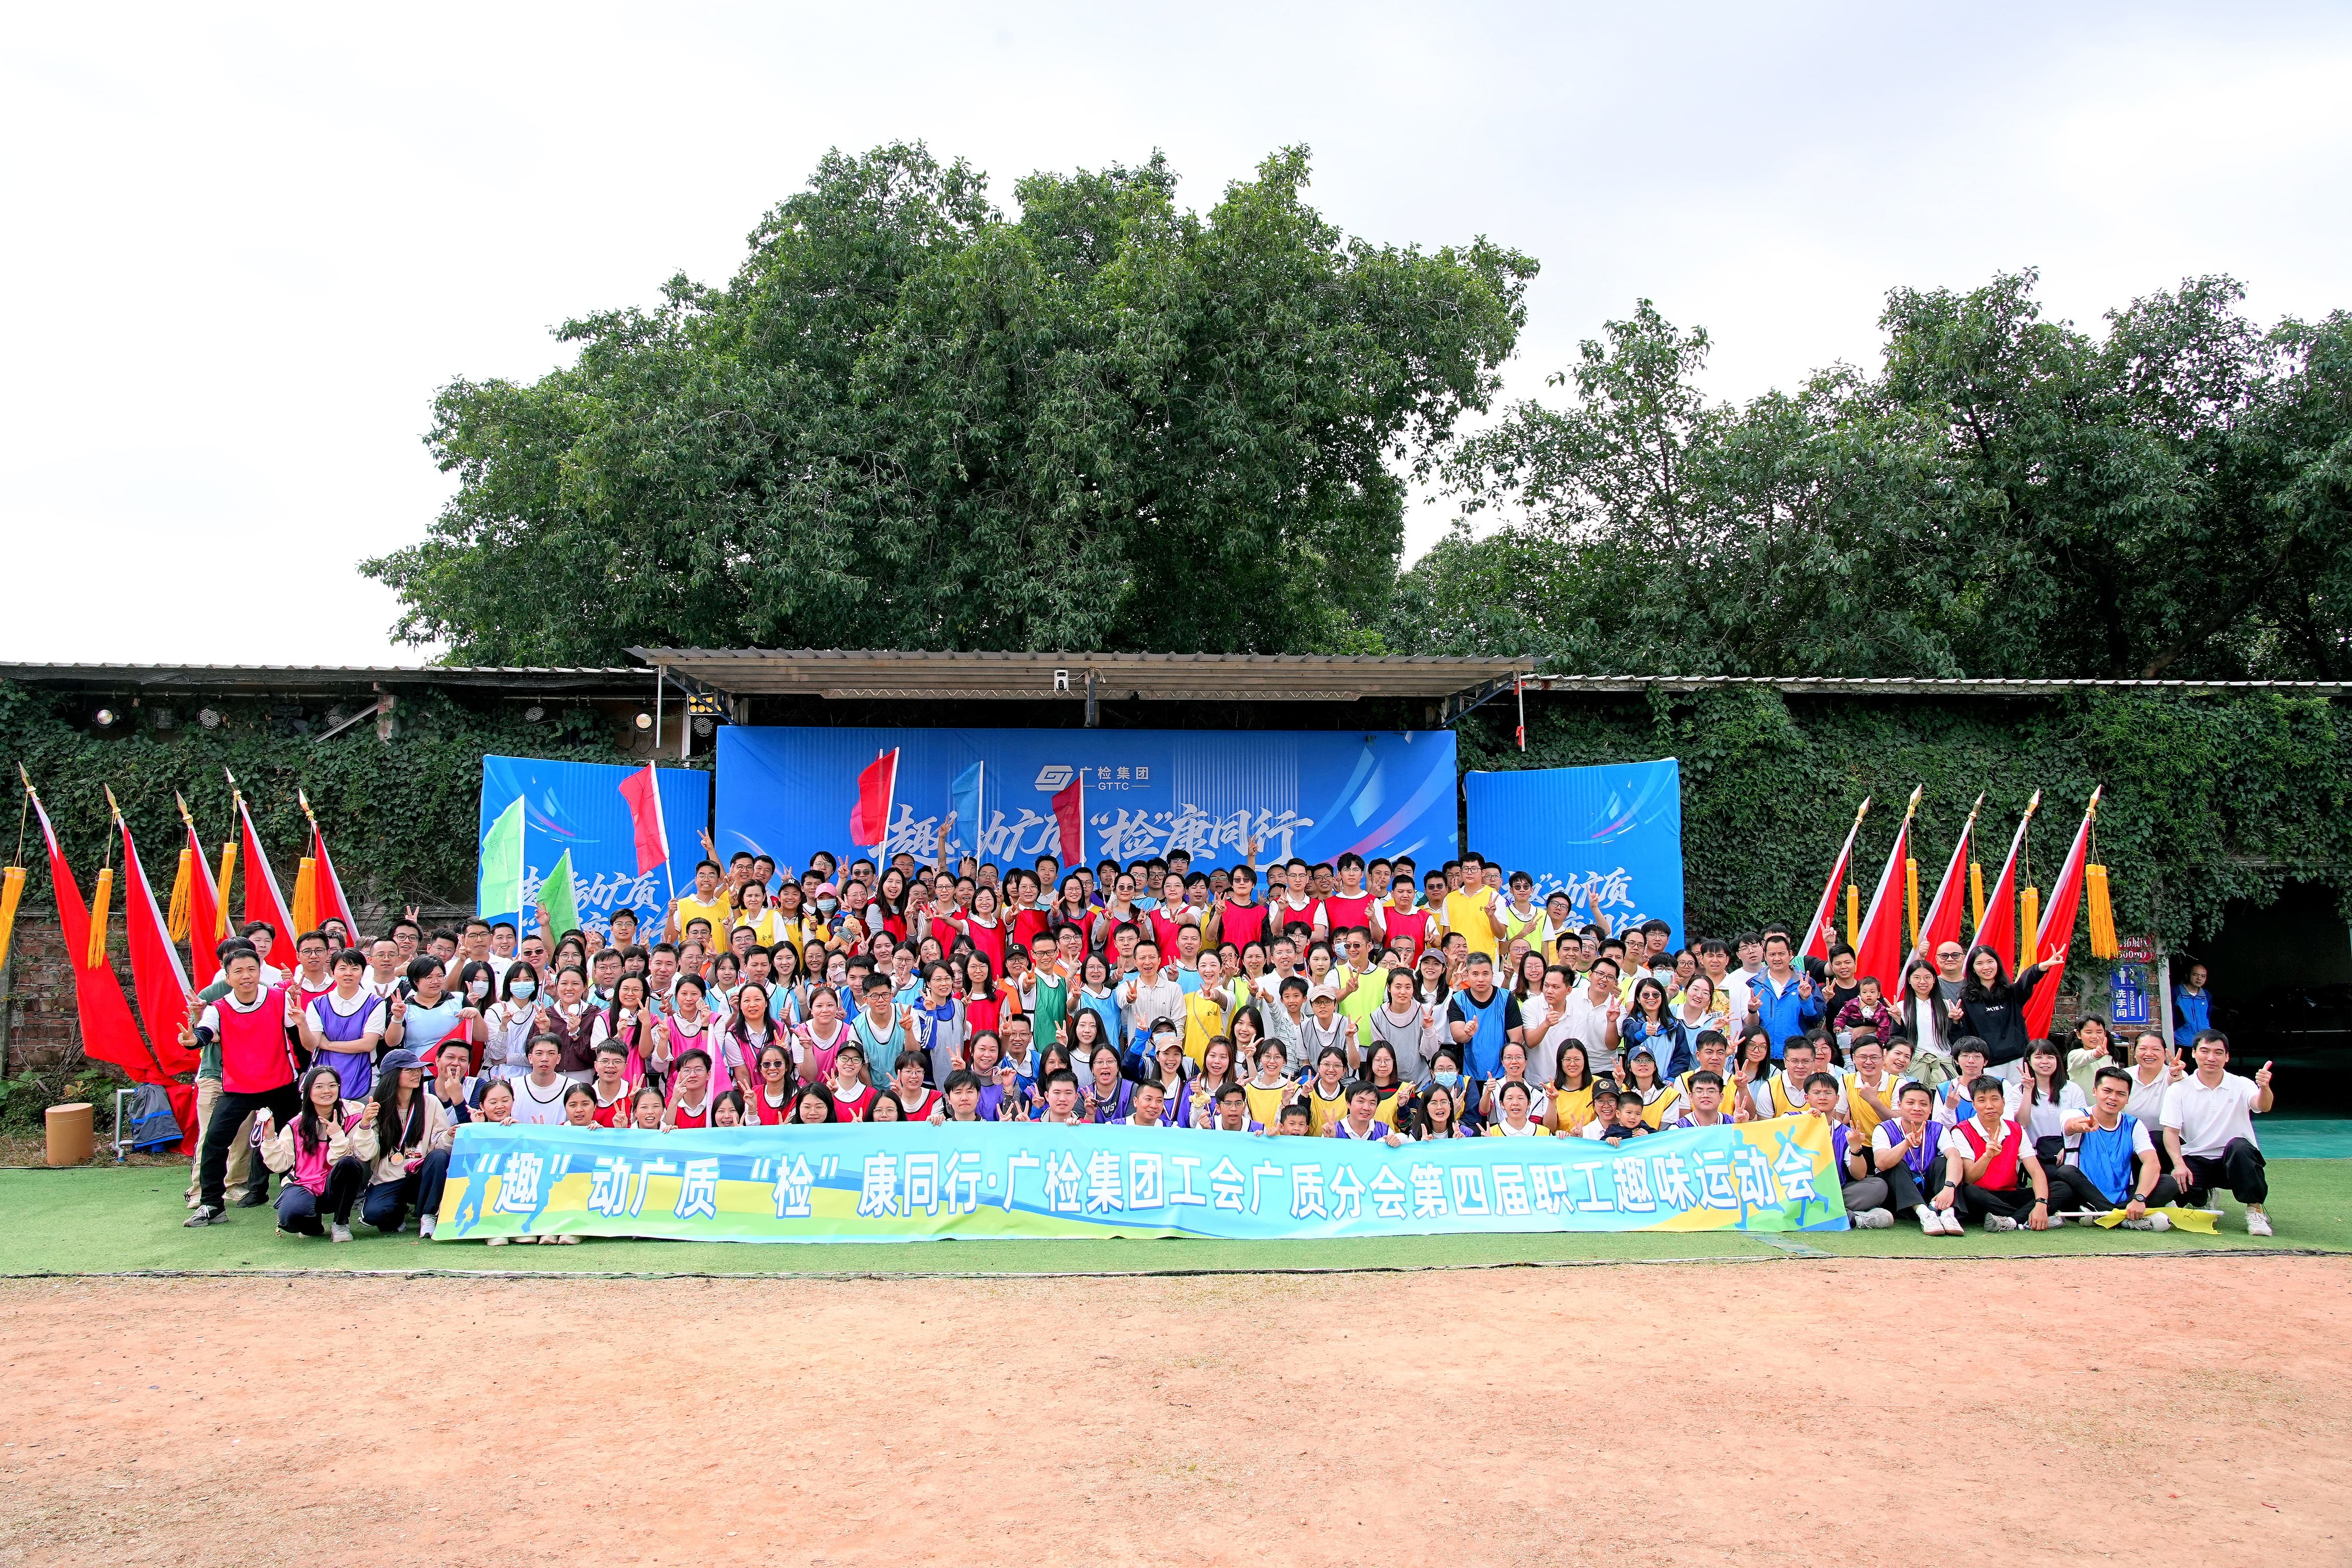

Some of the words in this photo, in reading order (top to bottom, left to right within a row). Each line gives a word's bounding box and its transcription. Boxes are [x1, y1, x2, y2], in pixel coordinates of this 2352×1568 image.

[1098, 782, 1129, 790] GTTC
[2115, 989, 2127, 1018] 洗手间
